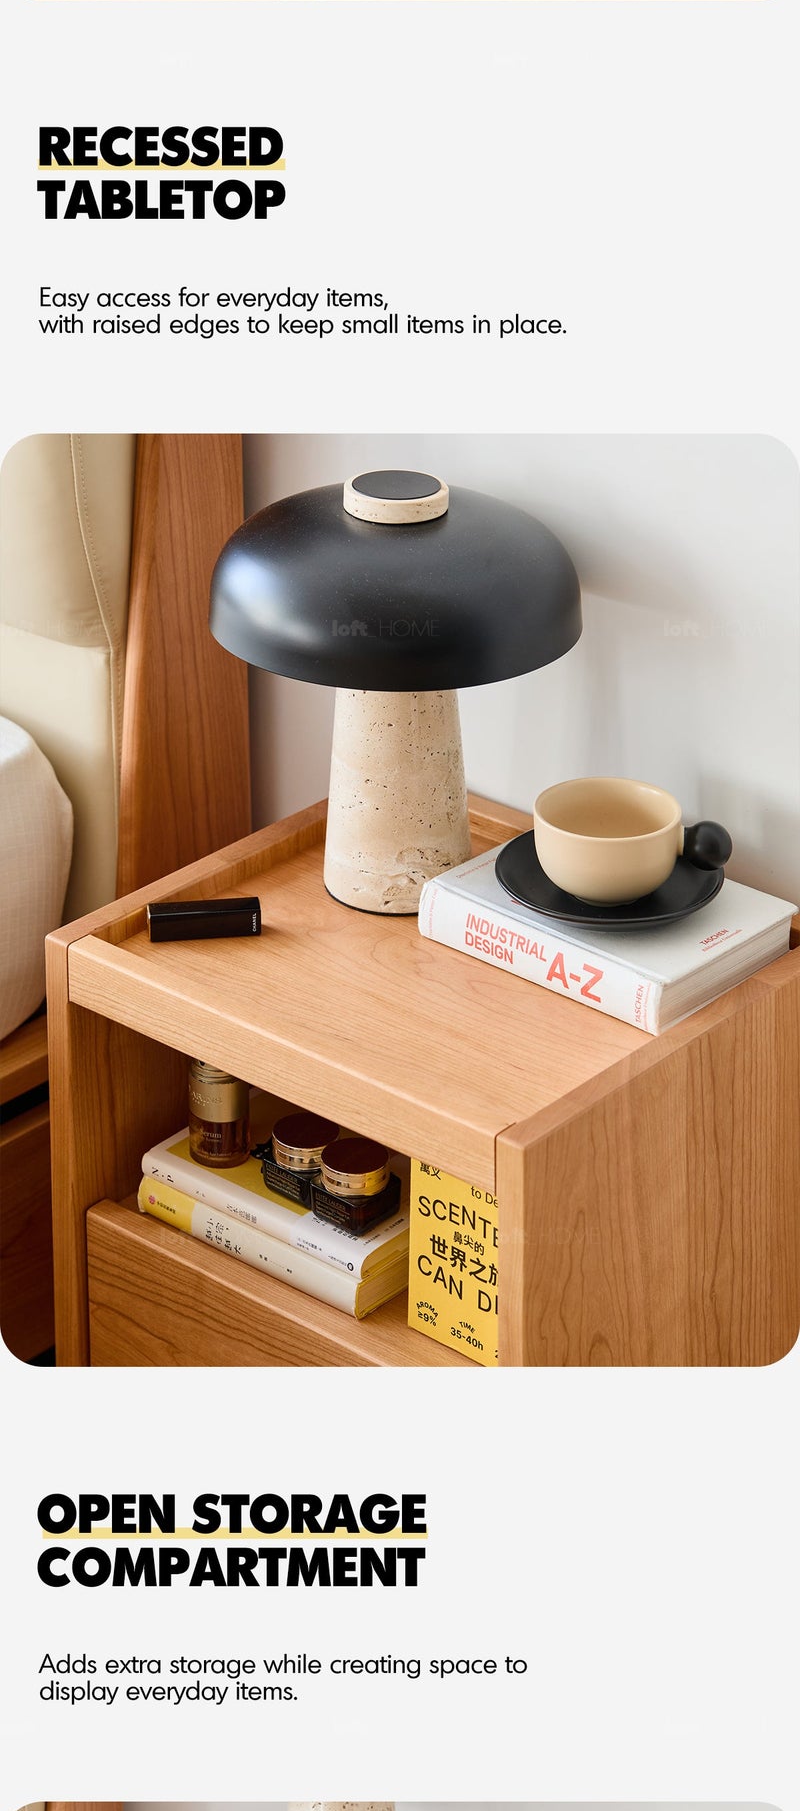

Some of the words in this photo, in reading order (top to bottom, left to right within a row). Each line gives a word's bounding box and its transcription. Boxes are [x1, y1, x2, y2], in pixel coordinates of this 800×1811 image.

[464, 931, 514, 965] DESIGN
[466, 913, 547, 962] INDUSTRIAL
[546, 952, 604, 1004] A-Z
[635, 984, 645, 1023] TASCHEN
[453, 1231, 485, 1256] 鼻尖的
[418, 1254, 463, 1300] CAN
[416, 1300, 439, 1318] AROMA
[450, 1326, 484, 1351] 35-40h
[458, 1321, 476, 1333] TIME
